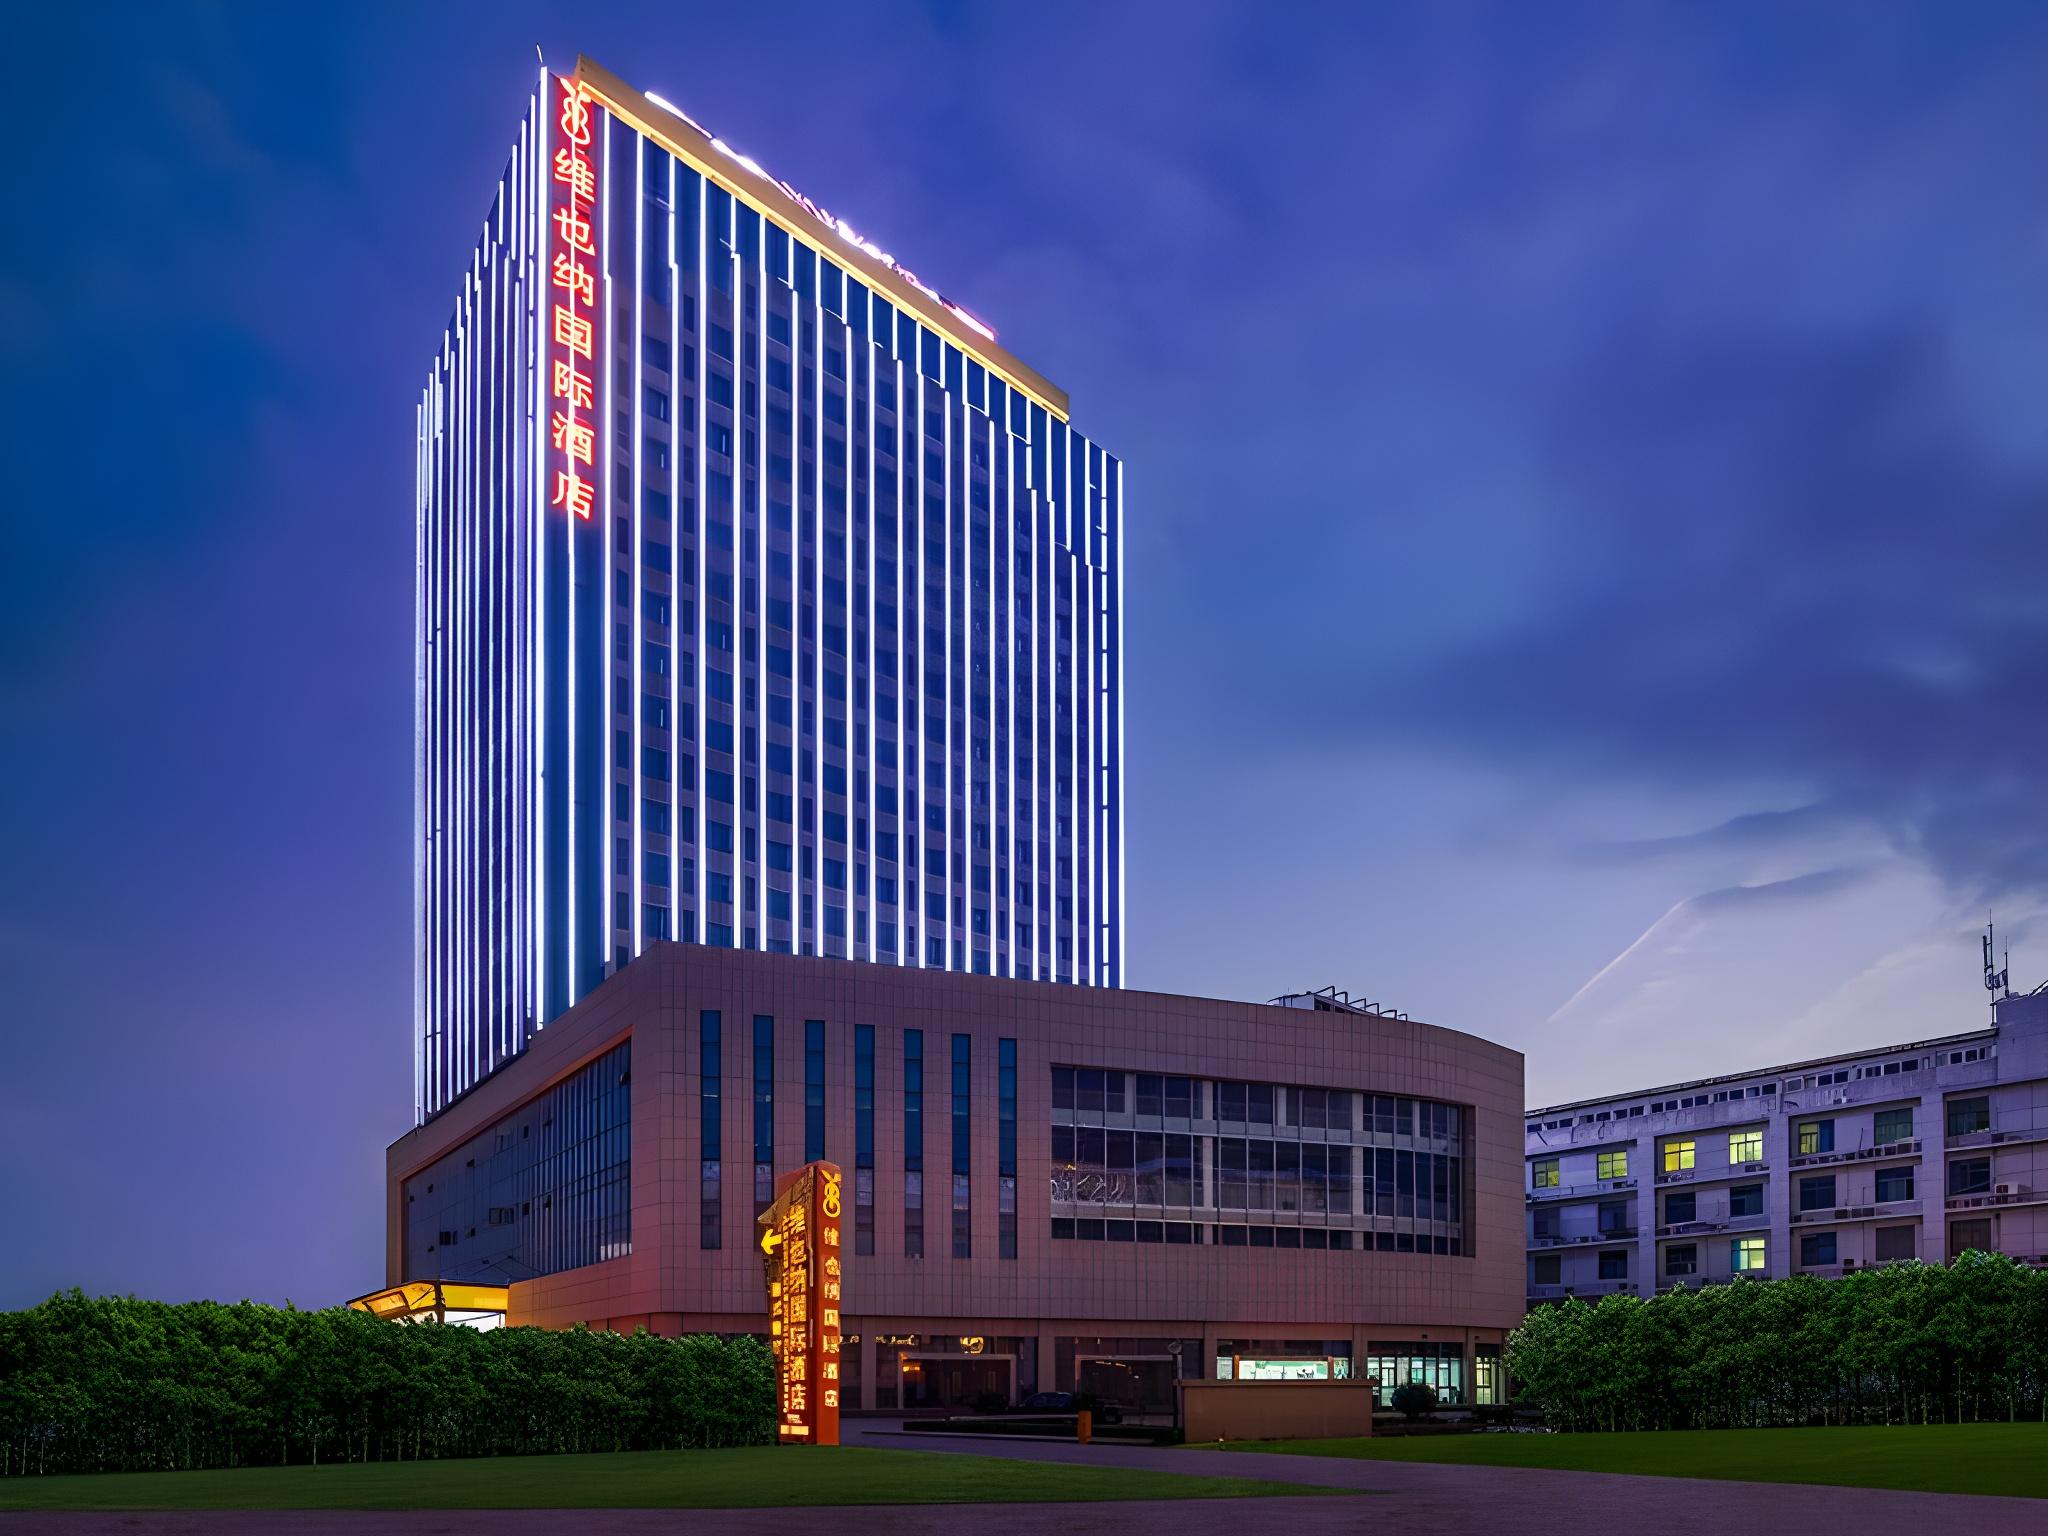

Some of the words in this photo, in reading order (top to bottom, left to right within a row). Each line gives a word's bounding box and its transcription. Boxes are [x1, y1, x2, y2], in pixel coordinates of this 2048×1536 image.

[552, 148, 596, 520] 维也纳国际酒店
